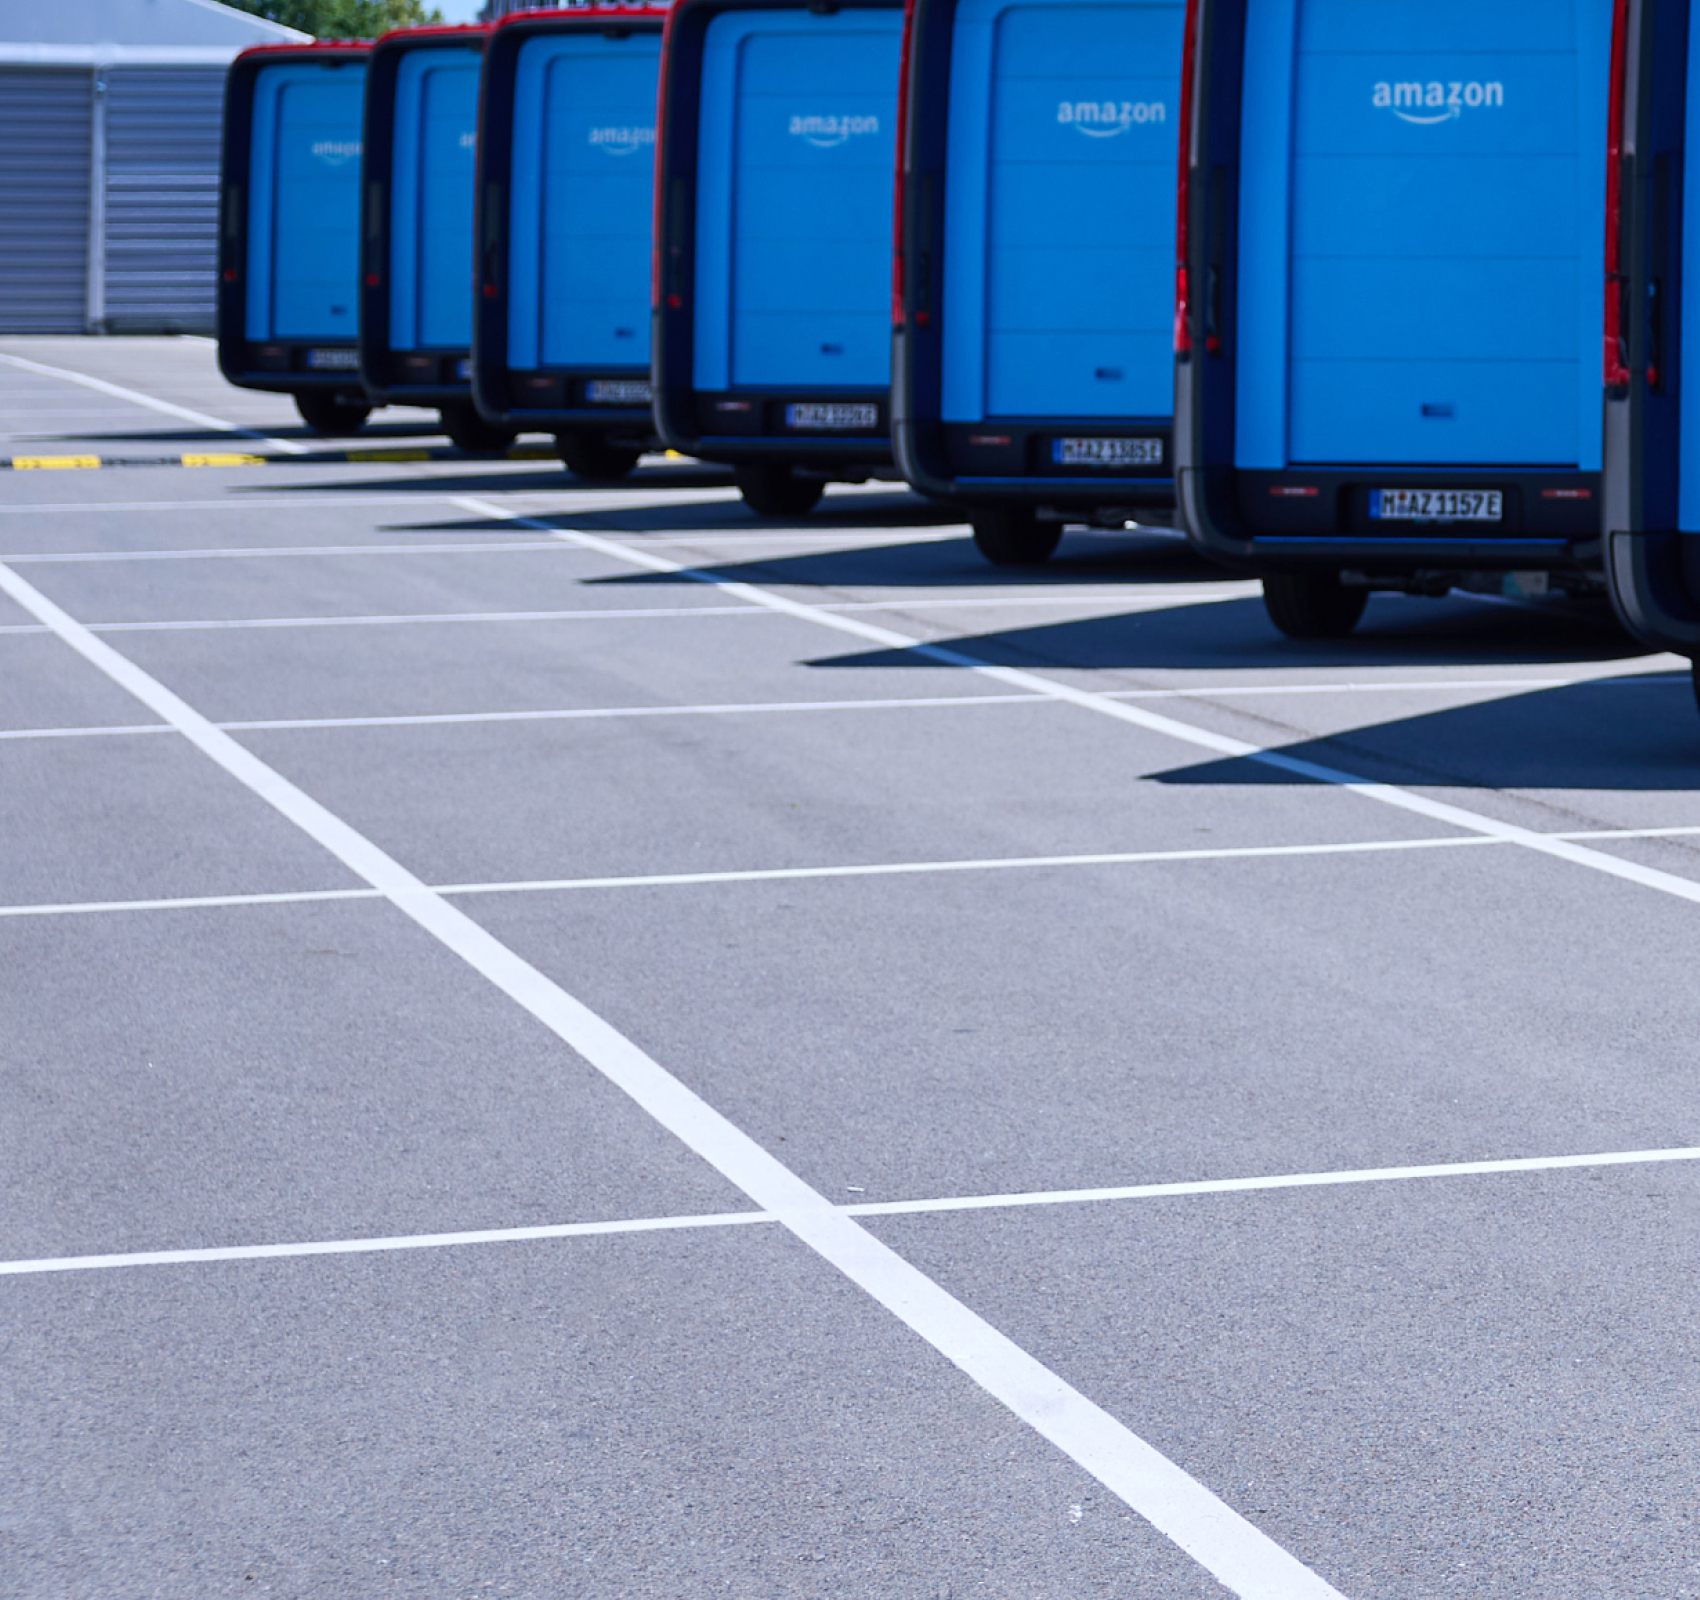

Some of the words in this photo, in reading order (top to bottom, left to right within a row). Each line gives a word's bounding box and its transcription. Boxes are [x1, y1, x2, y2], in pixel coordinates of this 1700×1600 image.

[1373, 81, 1503, 107] amazon
[1058, 101, 1165, 124] amazon
[789, 115, 879, 134] amazon
[312, 141, 362, 155] amazo
